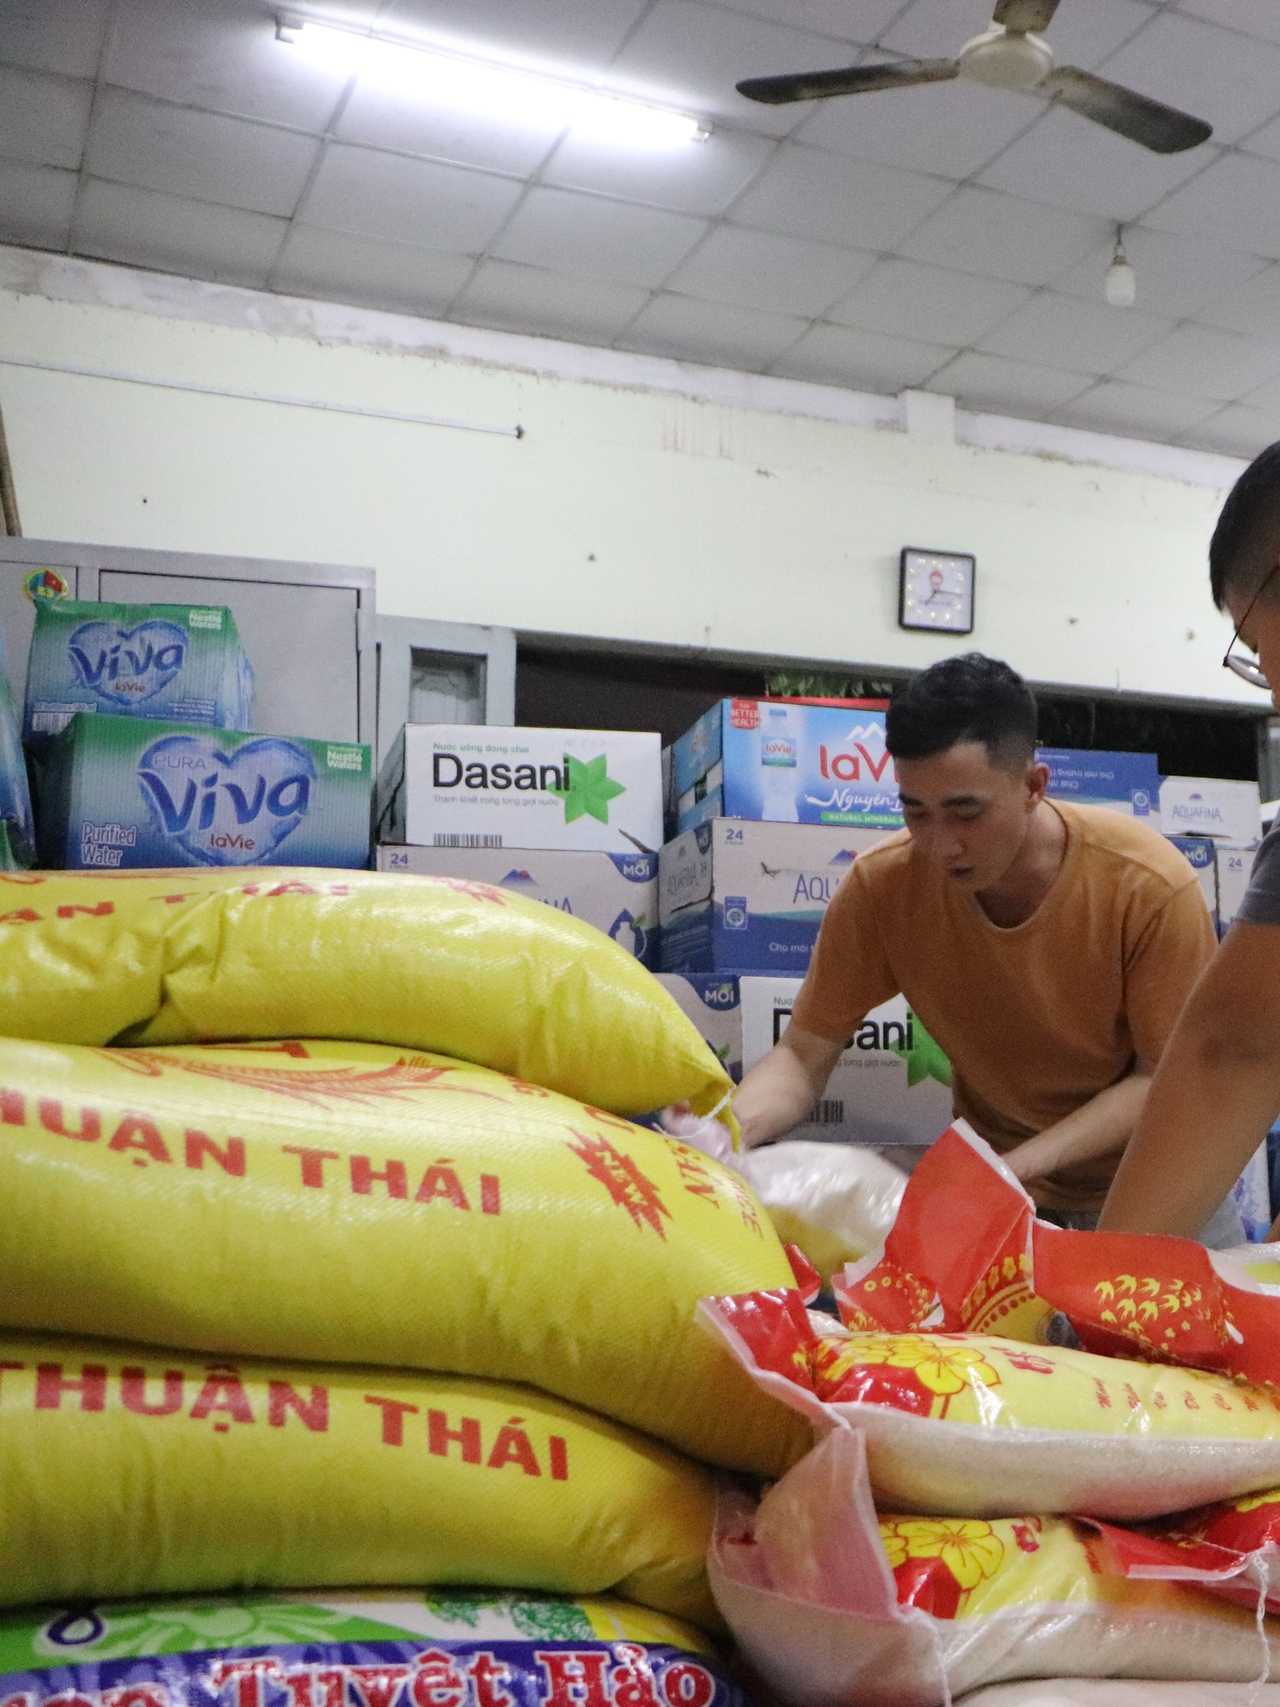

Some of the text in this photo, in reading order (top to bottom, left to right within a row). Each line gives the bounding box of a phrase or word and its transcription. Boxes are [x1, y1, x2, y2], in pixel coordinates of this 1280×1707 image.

[729, 708, 761, 718] BETTER
[729, 717, 761, 727] HEALTH
[766, 743, 793, 754] laVie
[154, 753, 207, 771] PURA
[819, 742, 898, 783] laV
[433, 752, 570, 791] Dasani
[1172, 804, 1222, 821] AQUAFINA
[81, 822, 137, 847] Purified
[726, 828, 744, 840] 24
[81, 844, 123, 867] Water
[390, 853, 408, 865] 24
[1228, 857, 1242, 868] 24
[282, 1145, 500, 1216] THÁI
[363, 1394, 568, 1481] THÁI
